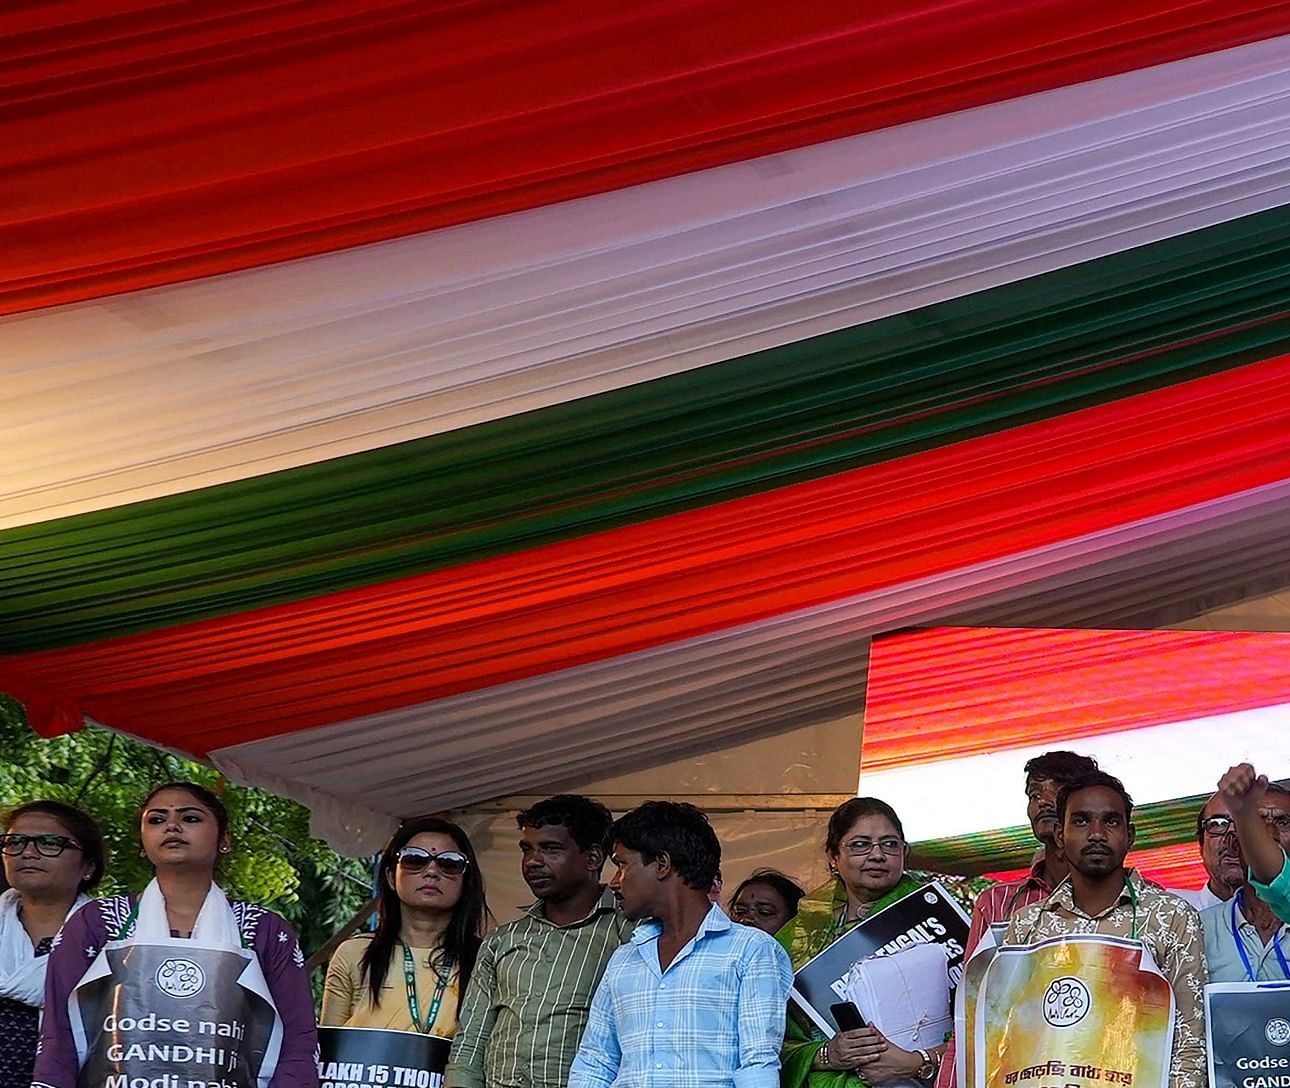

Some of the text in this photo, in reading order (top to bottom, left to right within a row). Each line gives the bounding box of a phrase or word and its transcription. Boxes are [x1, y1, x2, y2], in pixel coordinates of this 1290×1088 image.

[103, 1013, 245, 1041] Godse nahi
[107, 1044, 238, 1073] GANDHI ji
[1236, 1056, 1288, 1070] Godse
[367, 1064, 388, 1083] 15
